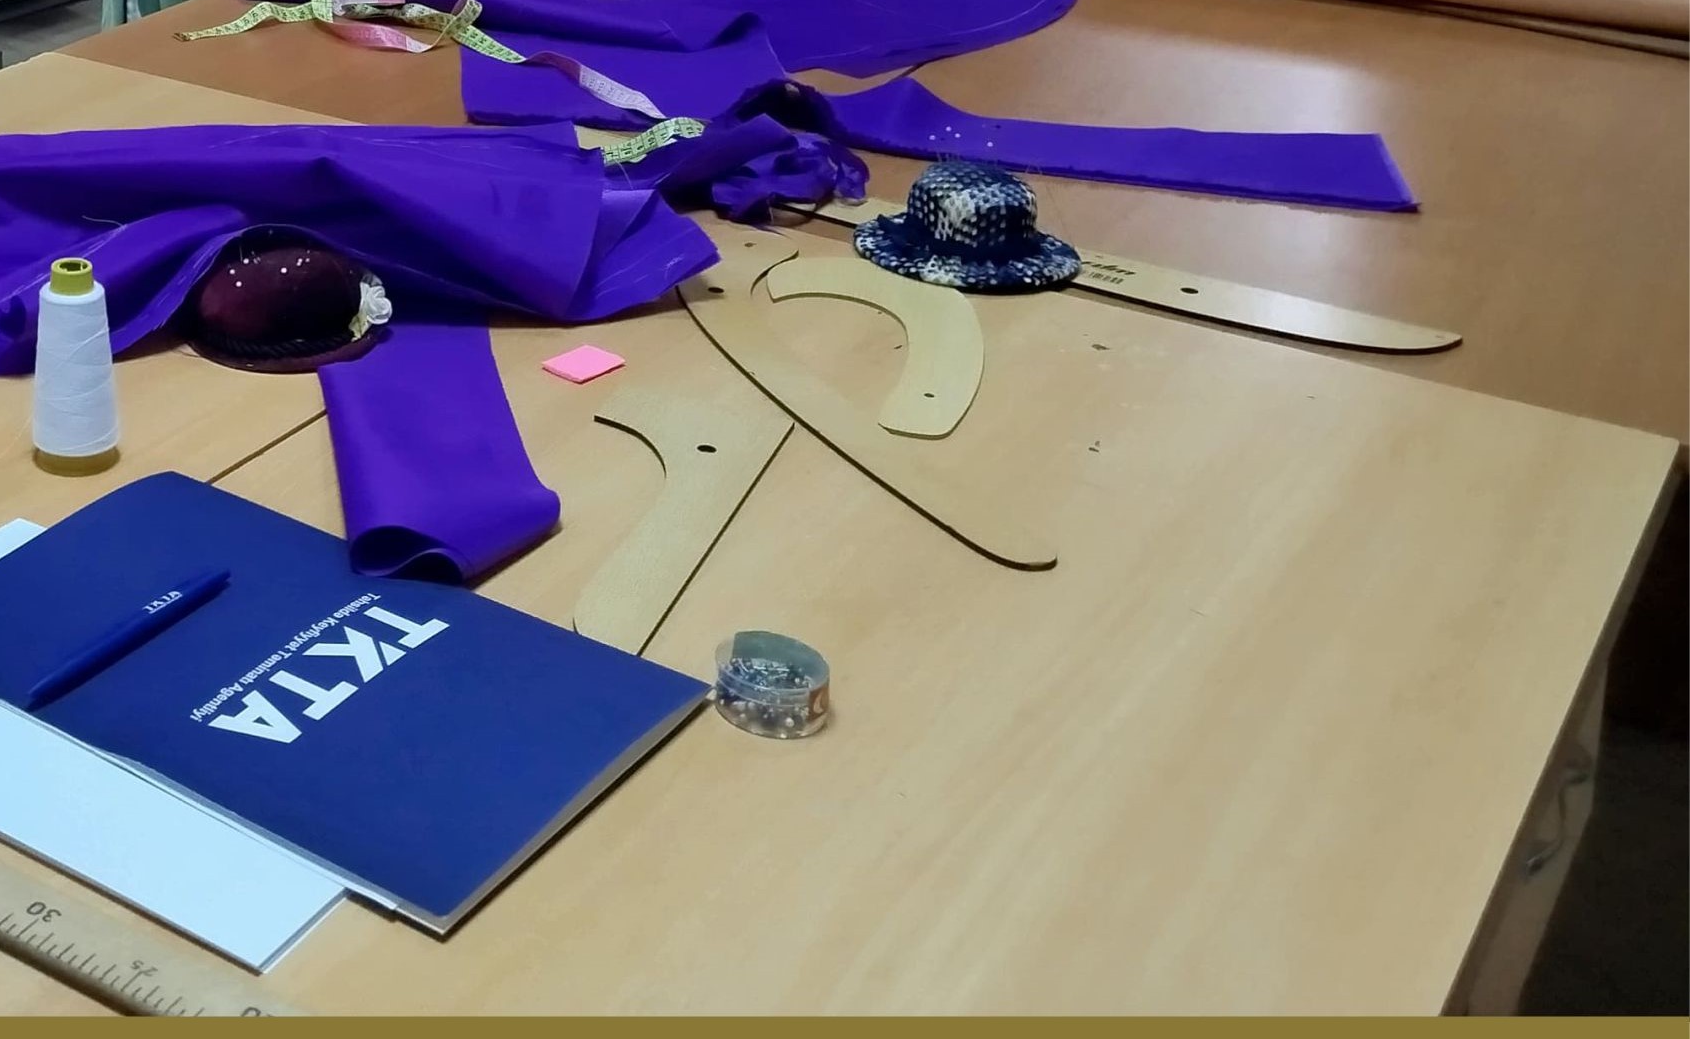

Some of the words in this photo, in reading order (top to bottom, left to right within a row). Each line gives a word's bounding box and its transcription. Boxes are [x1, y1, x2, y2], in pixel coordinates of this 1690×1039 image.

[332, 592, 381, 620] Təhsildə
[285, 616, 340, 652] Keyfiyyət
[208, 606, 450, 744] TKTA
[189, 681, 244, 722] Agentliyi
[26, 901, 62, 923] 30
[132, 959, 159, 977] 25
